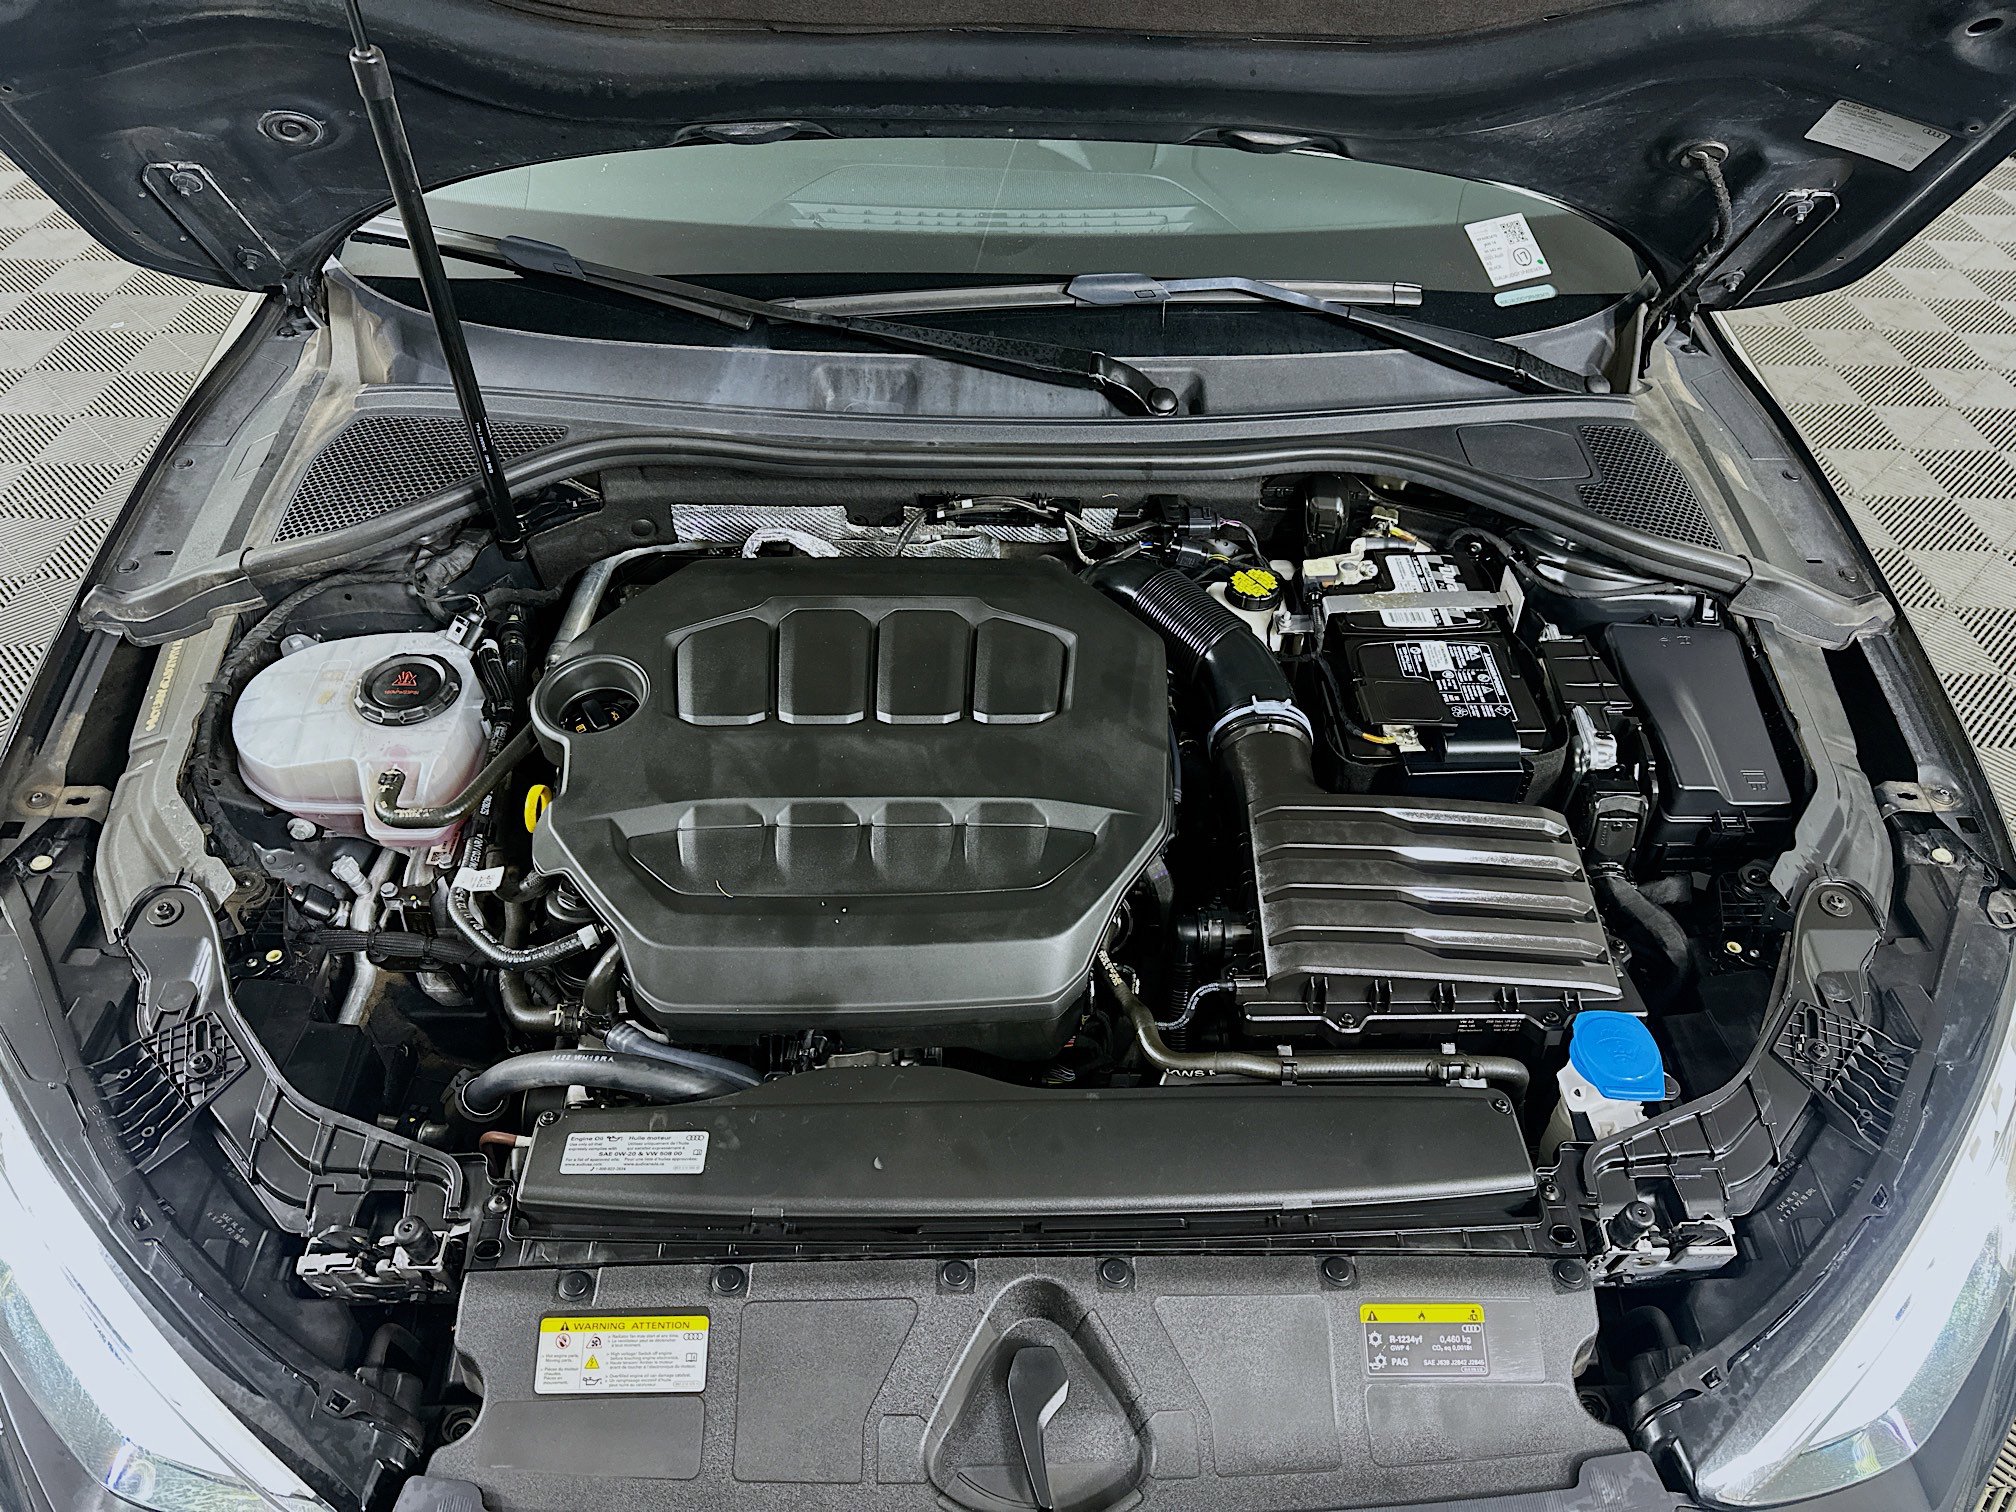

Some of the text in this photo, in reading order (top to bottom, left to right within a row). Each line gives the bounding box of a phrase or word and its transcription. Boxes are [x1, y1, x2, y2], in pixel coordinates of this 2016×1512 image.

[1840, 101, 1862, 110] AUDI
[221, 1213, 232, 1223] SAE
[574, 1321, 690, 1330] WARNING ATTENTION
[1389, 1335, 1423, 1345] R-1234yf
[1462, 1335, 1471, 1344] kg
[1391, 1358, 1408, 1366] PAG
